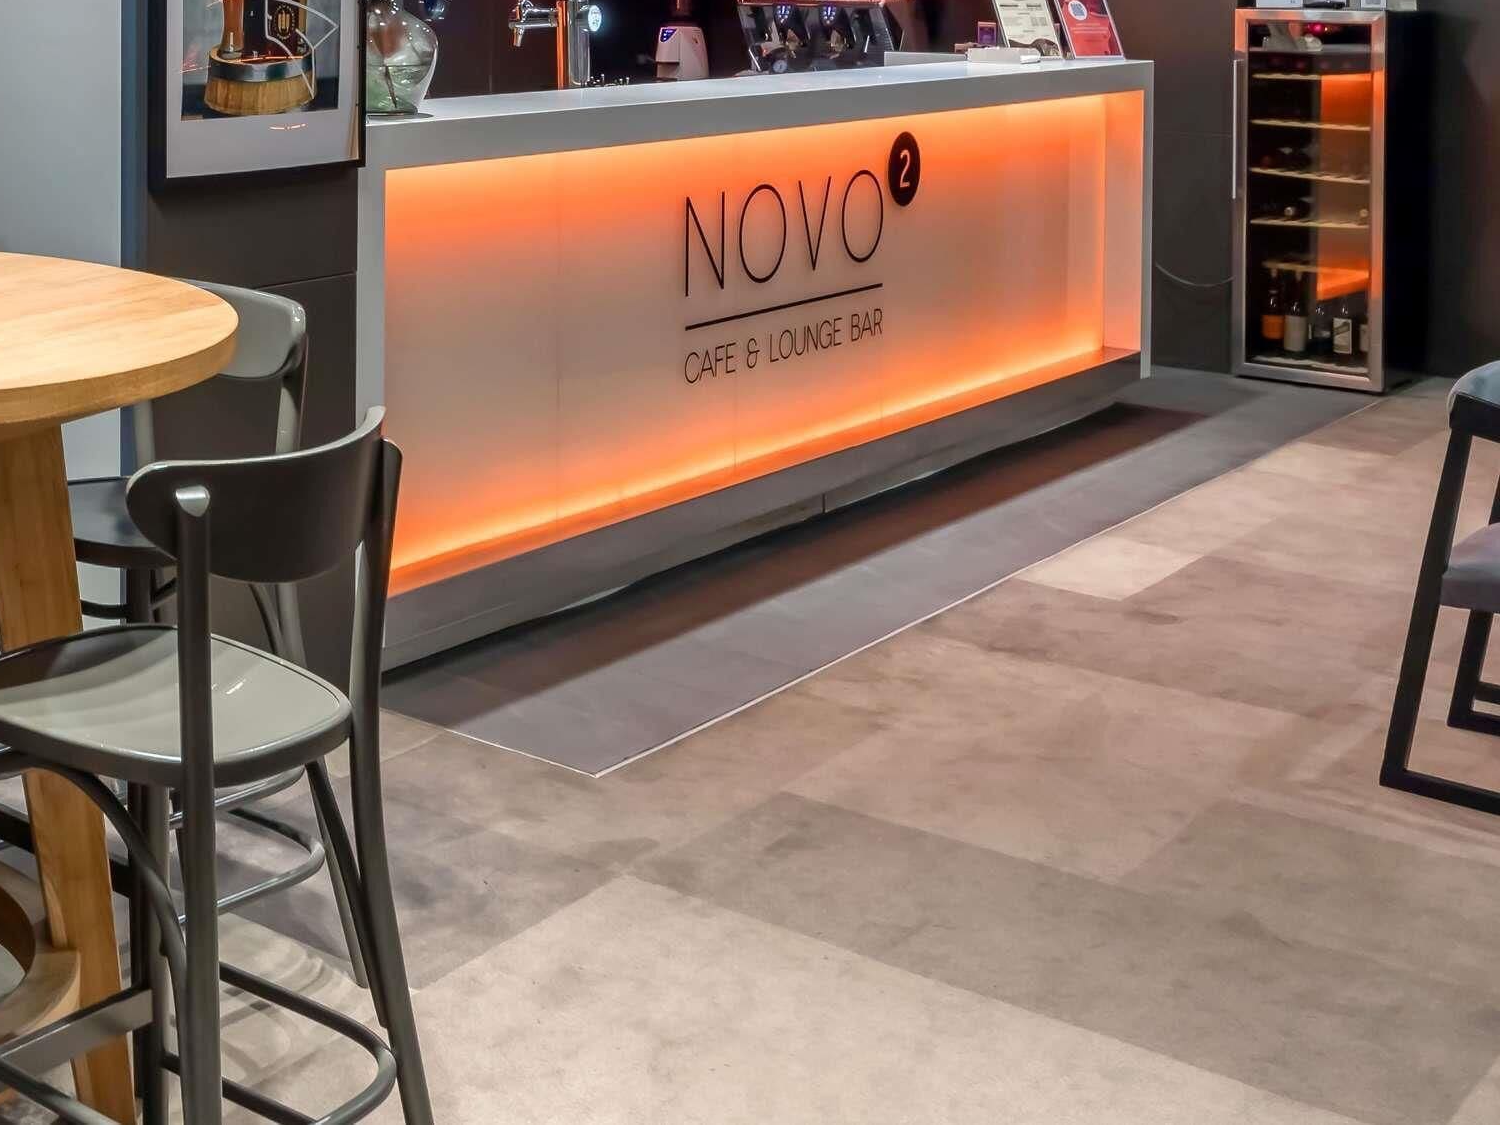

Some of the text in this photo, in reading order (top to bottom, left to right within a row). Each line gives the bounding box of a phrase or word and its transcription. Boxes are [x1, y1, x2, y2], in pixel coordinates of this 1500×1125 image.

[685, 169, 884, 297] NOVO
[684, 308, 884, 384] CAFE & LOUNGE BAR
